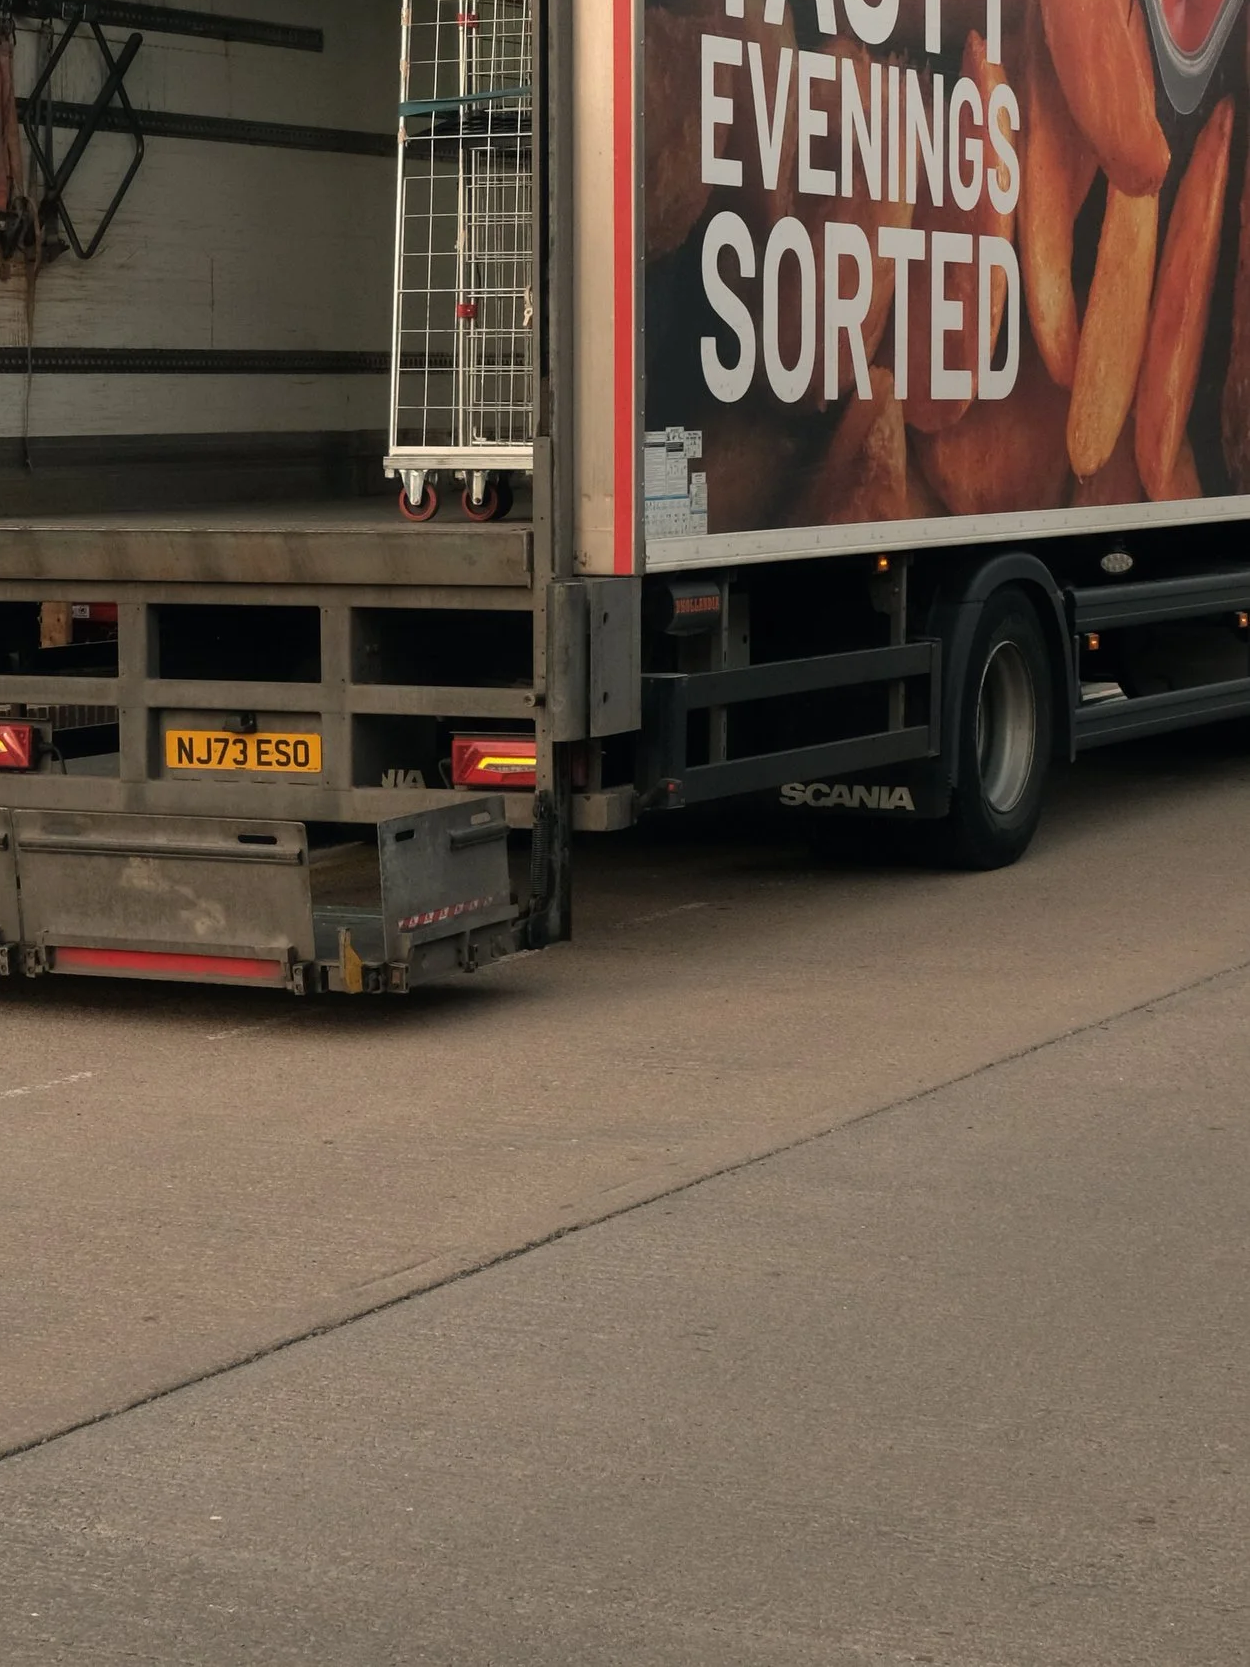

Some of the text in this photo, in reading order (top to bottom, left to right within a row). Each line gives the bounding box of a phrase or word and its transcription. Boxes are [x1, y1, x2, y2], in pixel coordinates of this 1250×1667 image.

[700, 34, 1021, 215] EVENINGS
[700, 210, 1021, 403] SORTED
[177, 736, 310, 767] NJ73 ESO
[779, 782, 915, 811] SCANIA
